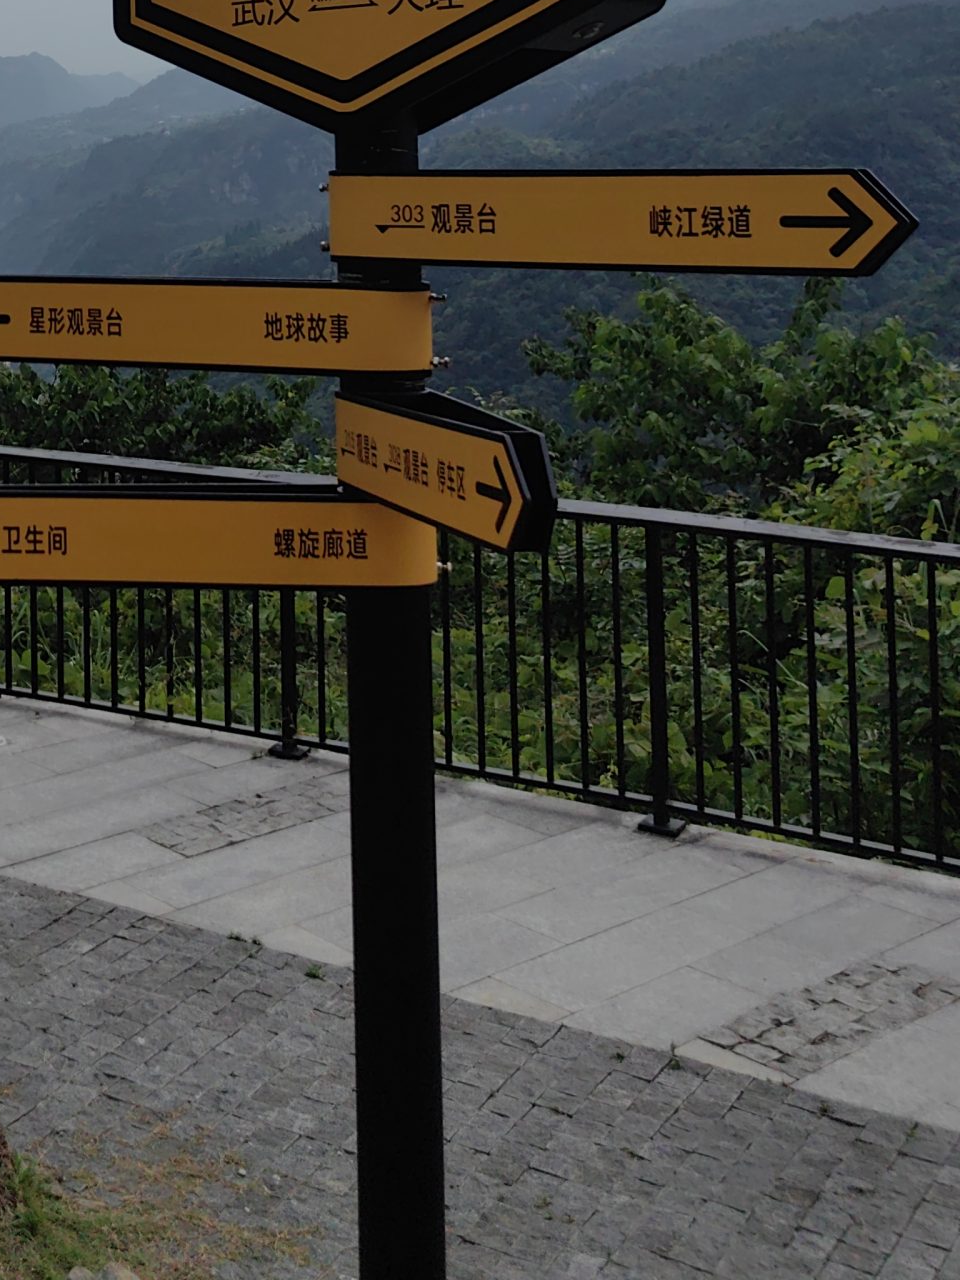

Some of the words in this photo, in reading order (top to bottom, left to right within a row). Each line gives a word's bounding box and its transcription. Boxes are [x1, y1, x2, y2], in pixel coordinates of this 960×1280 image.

[390, 204, 425, 223] 303
[430, 202, 498, 236] 观景台
[649, 204, 753, 240] 峡江绿道
[29, 306, 124, 338] 星形观景台
[263, 311, 350, 344] 地球故事
[1, 525, 69, 556] 卫生间
[273, 527, 369, 560] 螺旋廊道
